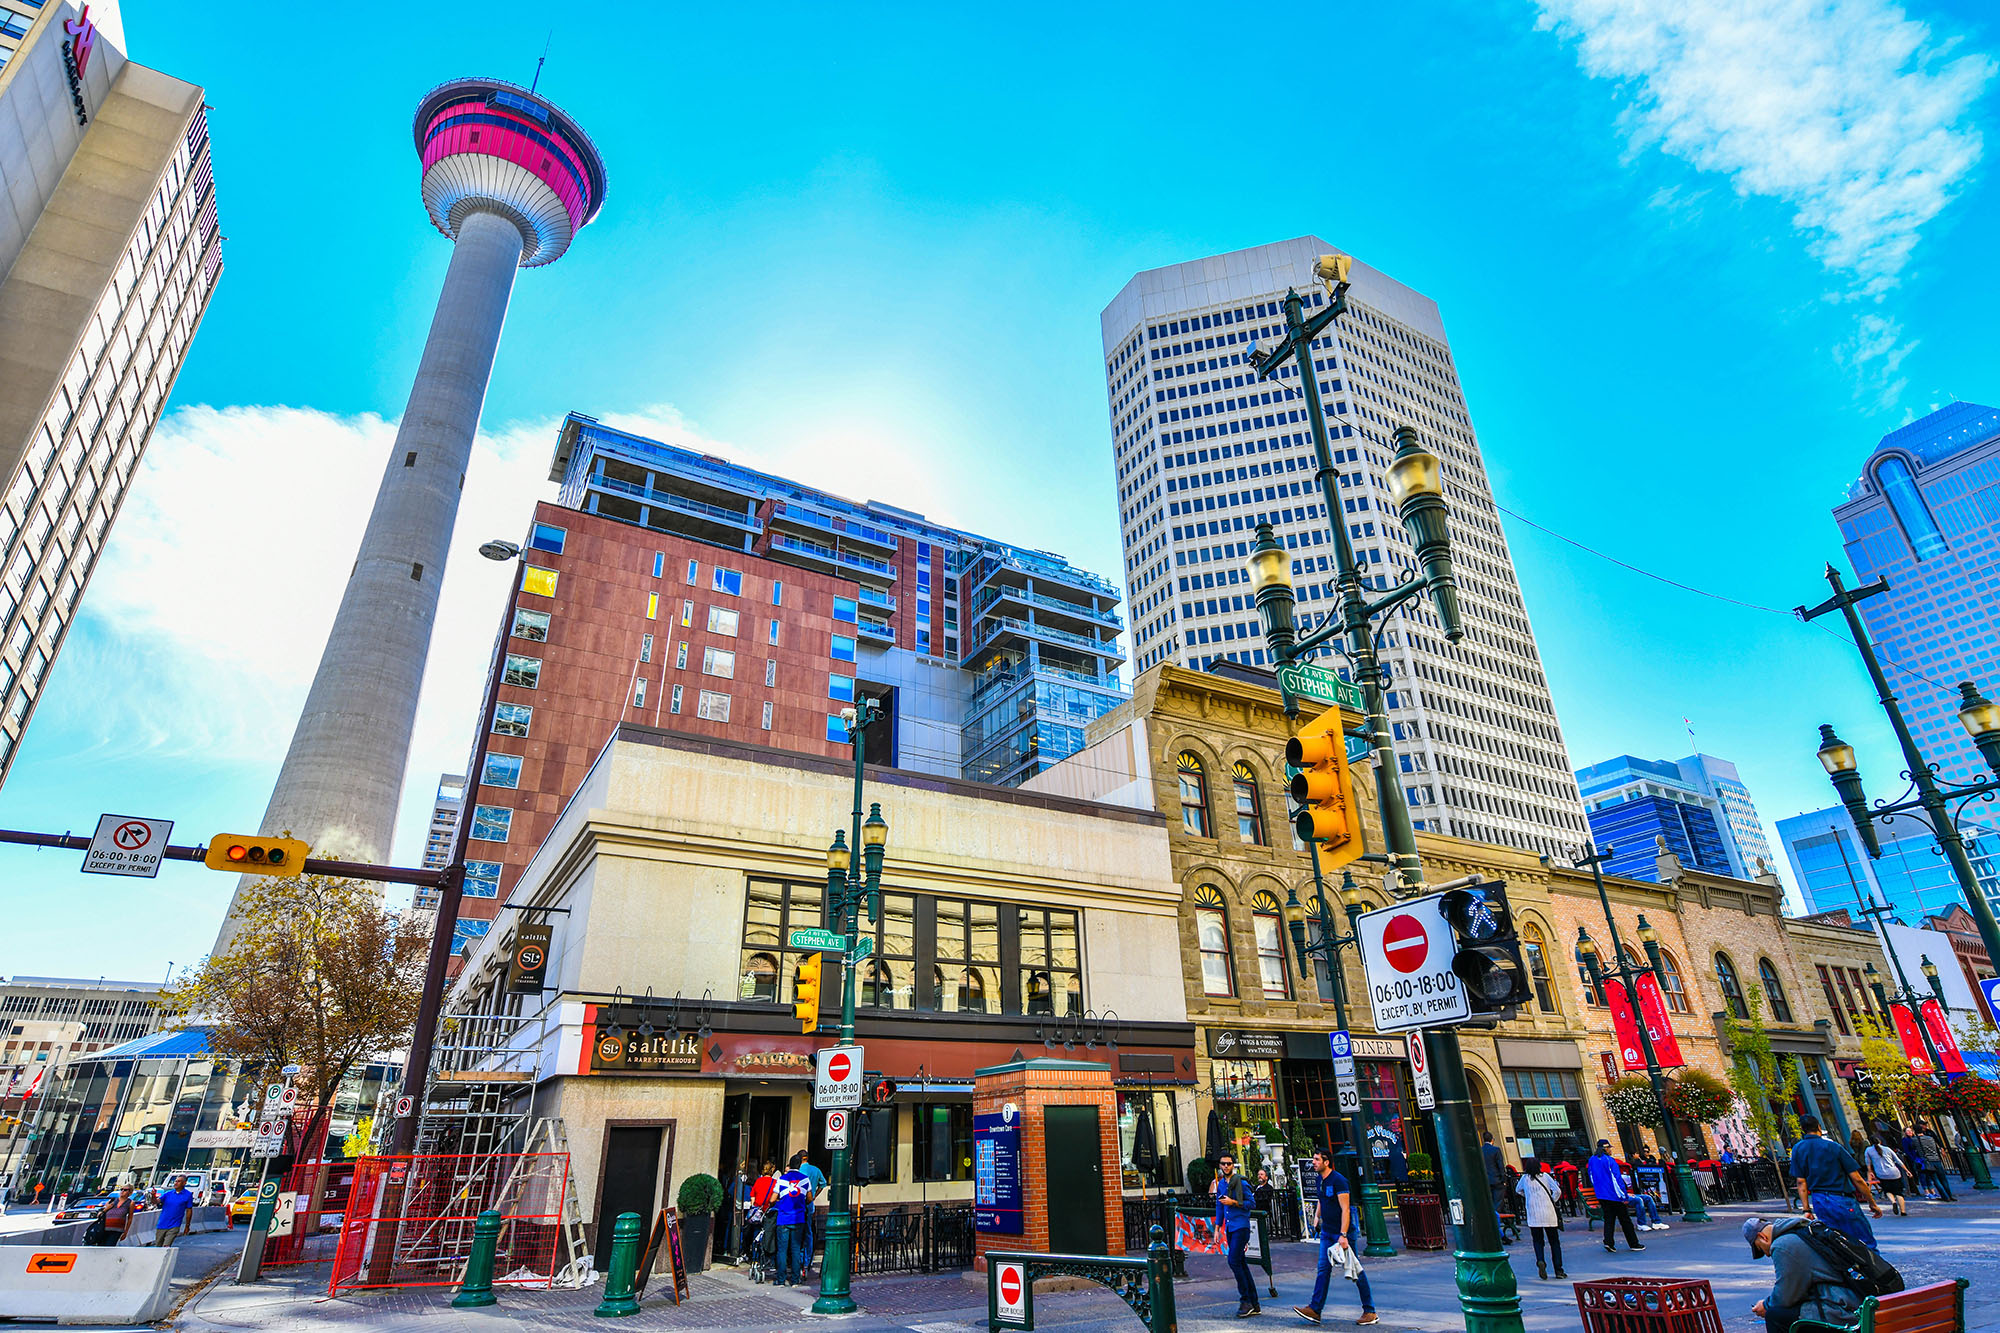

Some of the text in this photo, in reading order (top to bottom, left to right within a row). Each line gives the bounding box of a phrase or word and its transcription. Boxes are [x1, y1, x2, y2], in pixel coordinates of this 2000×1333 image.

[1312, 670, 1323, 680] AVE
[1324, 673, 1335, 682] SW
[1288, 673, 1354, 704] STEPHEN AVE
[92, 850, 157, 863] 06:00-18:00
[89, 861, 115, 870] EXCEPT
[128, 864, 152, 873] PERMIT
[796, 935, 840, 947] STEPHEN AVE
[1375, 970, 1456, 1003] 06:00-18:00
[1381, 995, 1458, 1020] EXCEPT BY PERMIT
[628, 1038, 698, 1055] saltlik
[1260, 1039, 1283, 1047] COMPANY
[1351, 1040, 1394, 1055] DINER
[818, 1082, 859, 1095] 06:00-18:00
[1340, 1091, 1358, 1107] 30
[789, 1180, 801, 1197] 3
